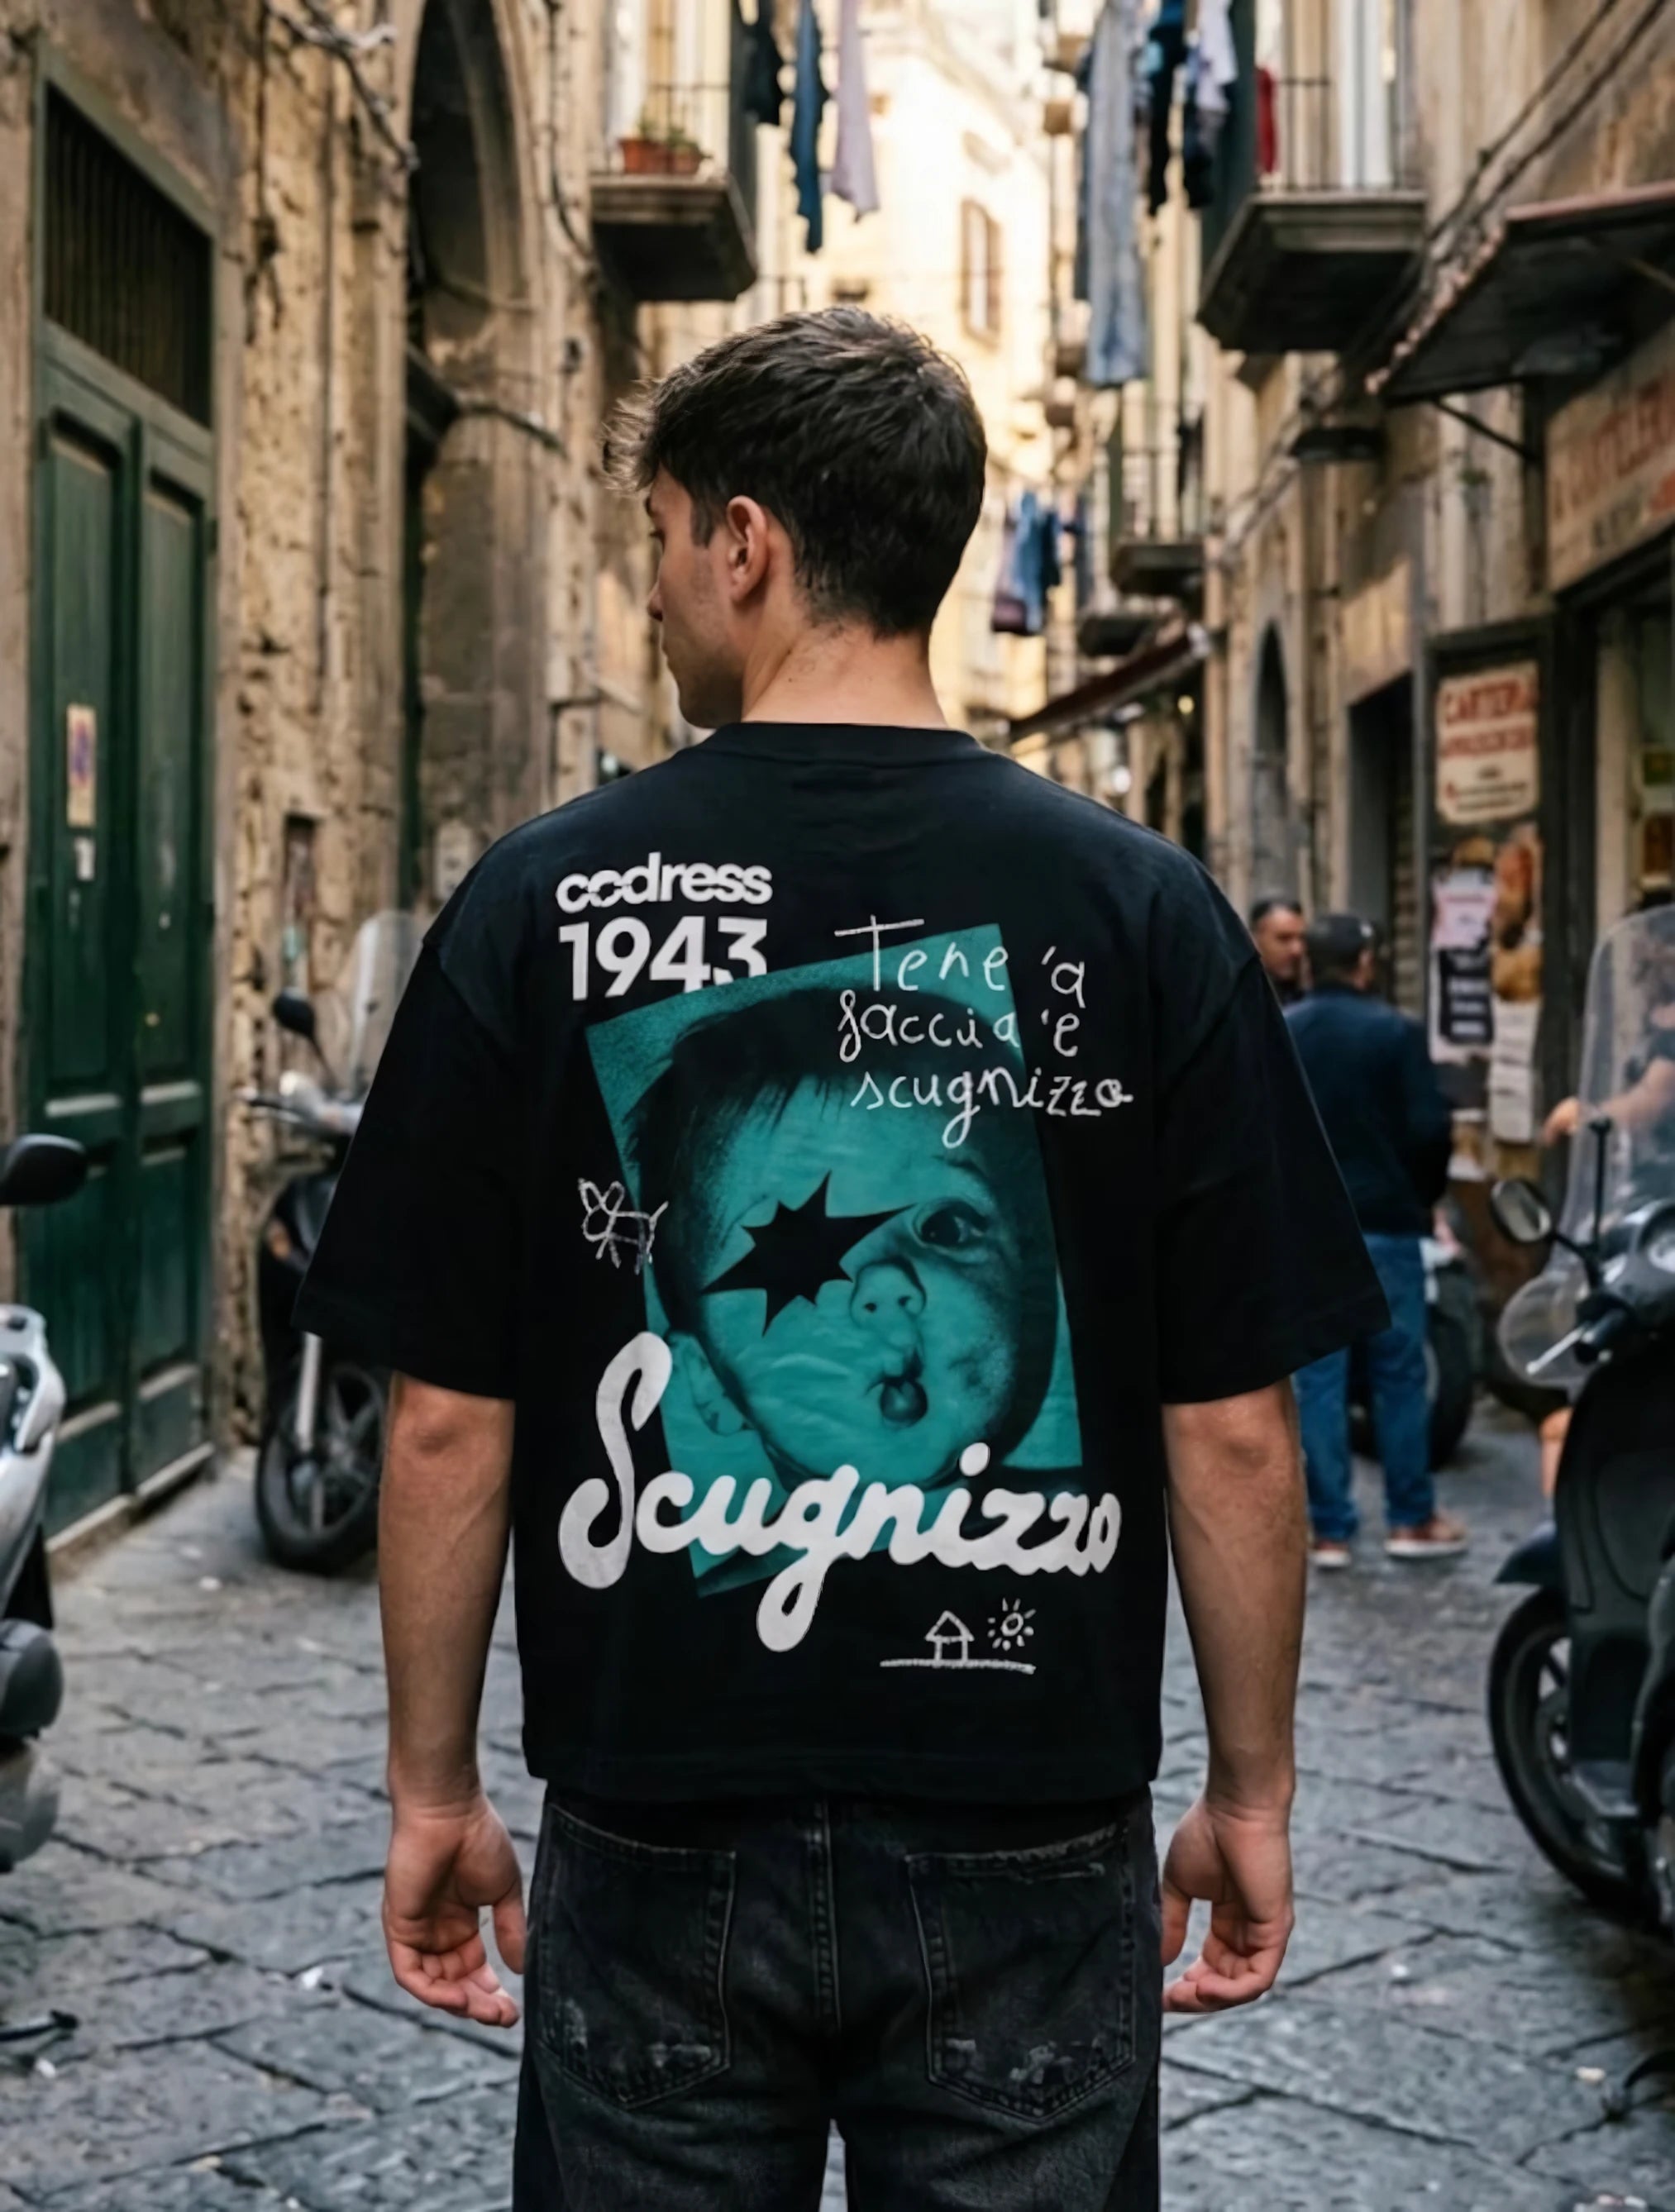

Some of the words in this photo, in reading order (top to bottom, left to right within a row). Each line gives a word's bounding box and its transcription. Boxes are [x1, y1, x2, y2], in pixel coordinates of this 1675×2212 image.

[559, 916, 767, 1000] 1943
[834, 915, 1009, 992] Tene
[838, 989, 1020, 1062] faccia
[850, 1065, 1133, 1149] scugnizzo
[558, 1331, 1122, 1652] Scugnizzo
